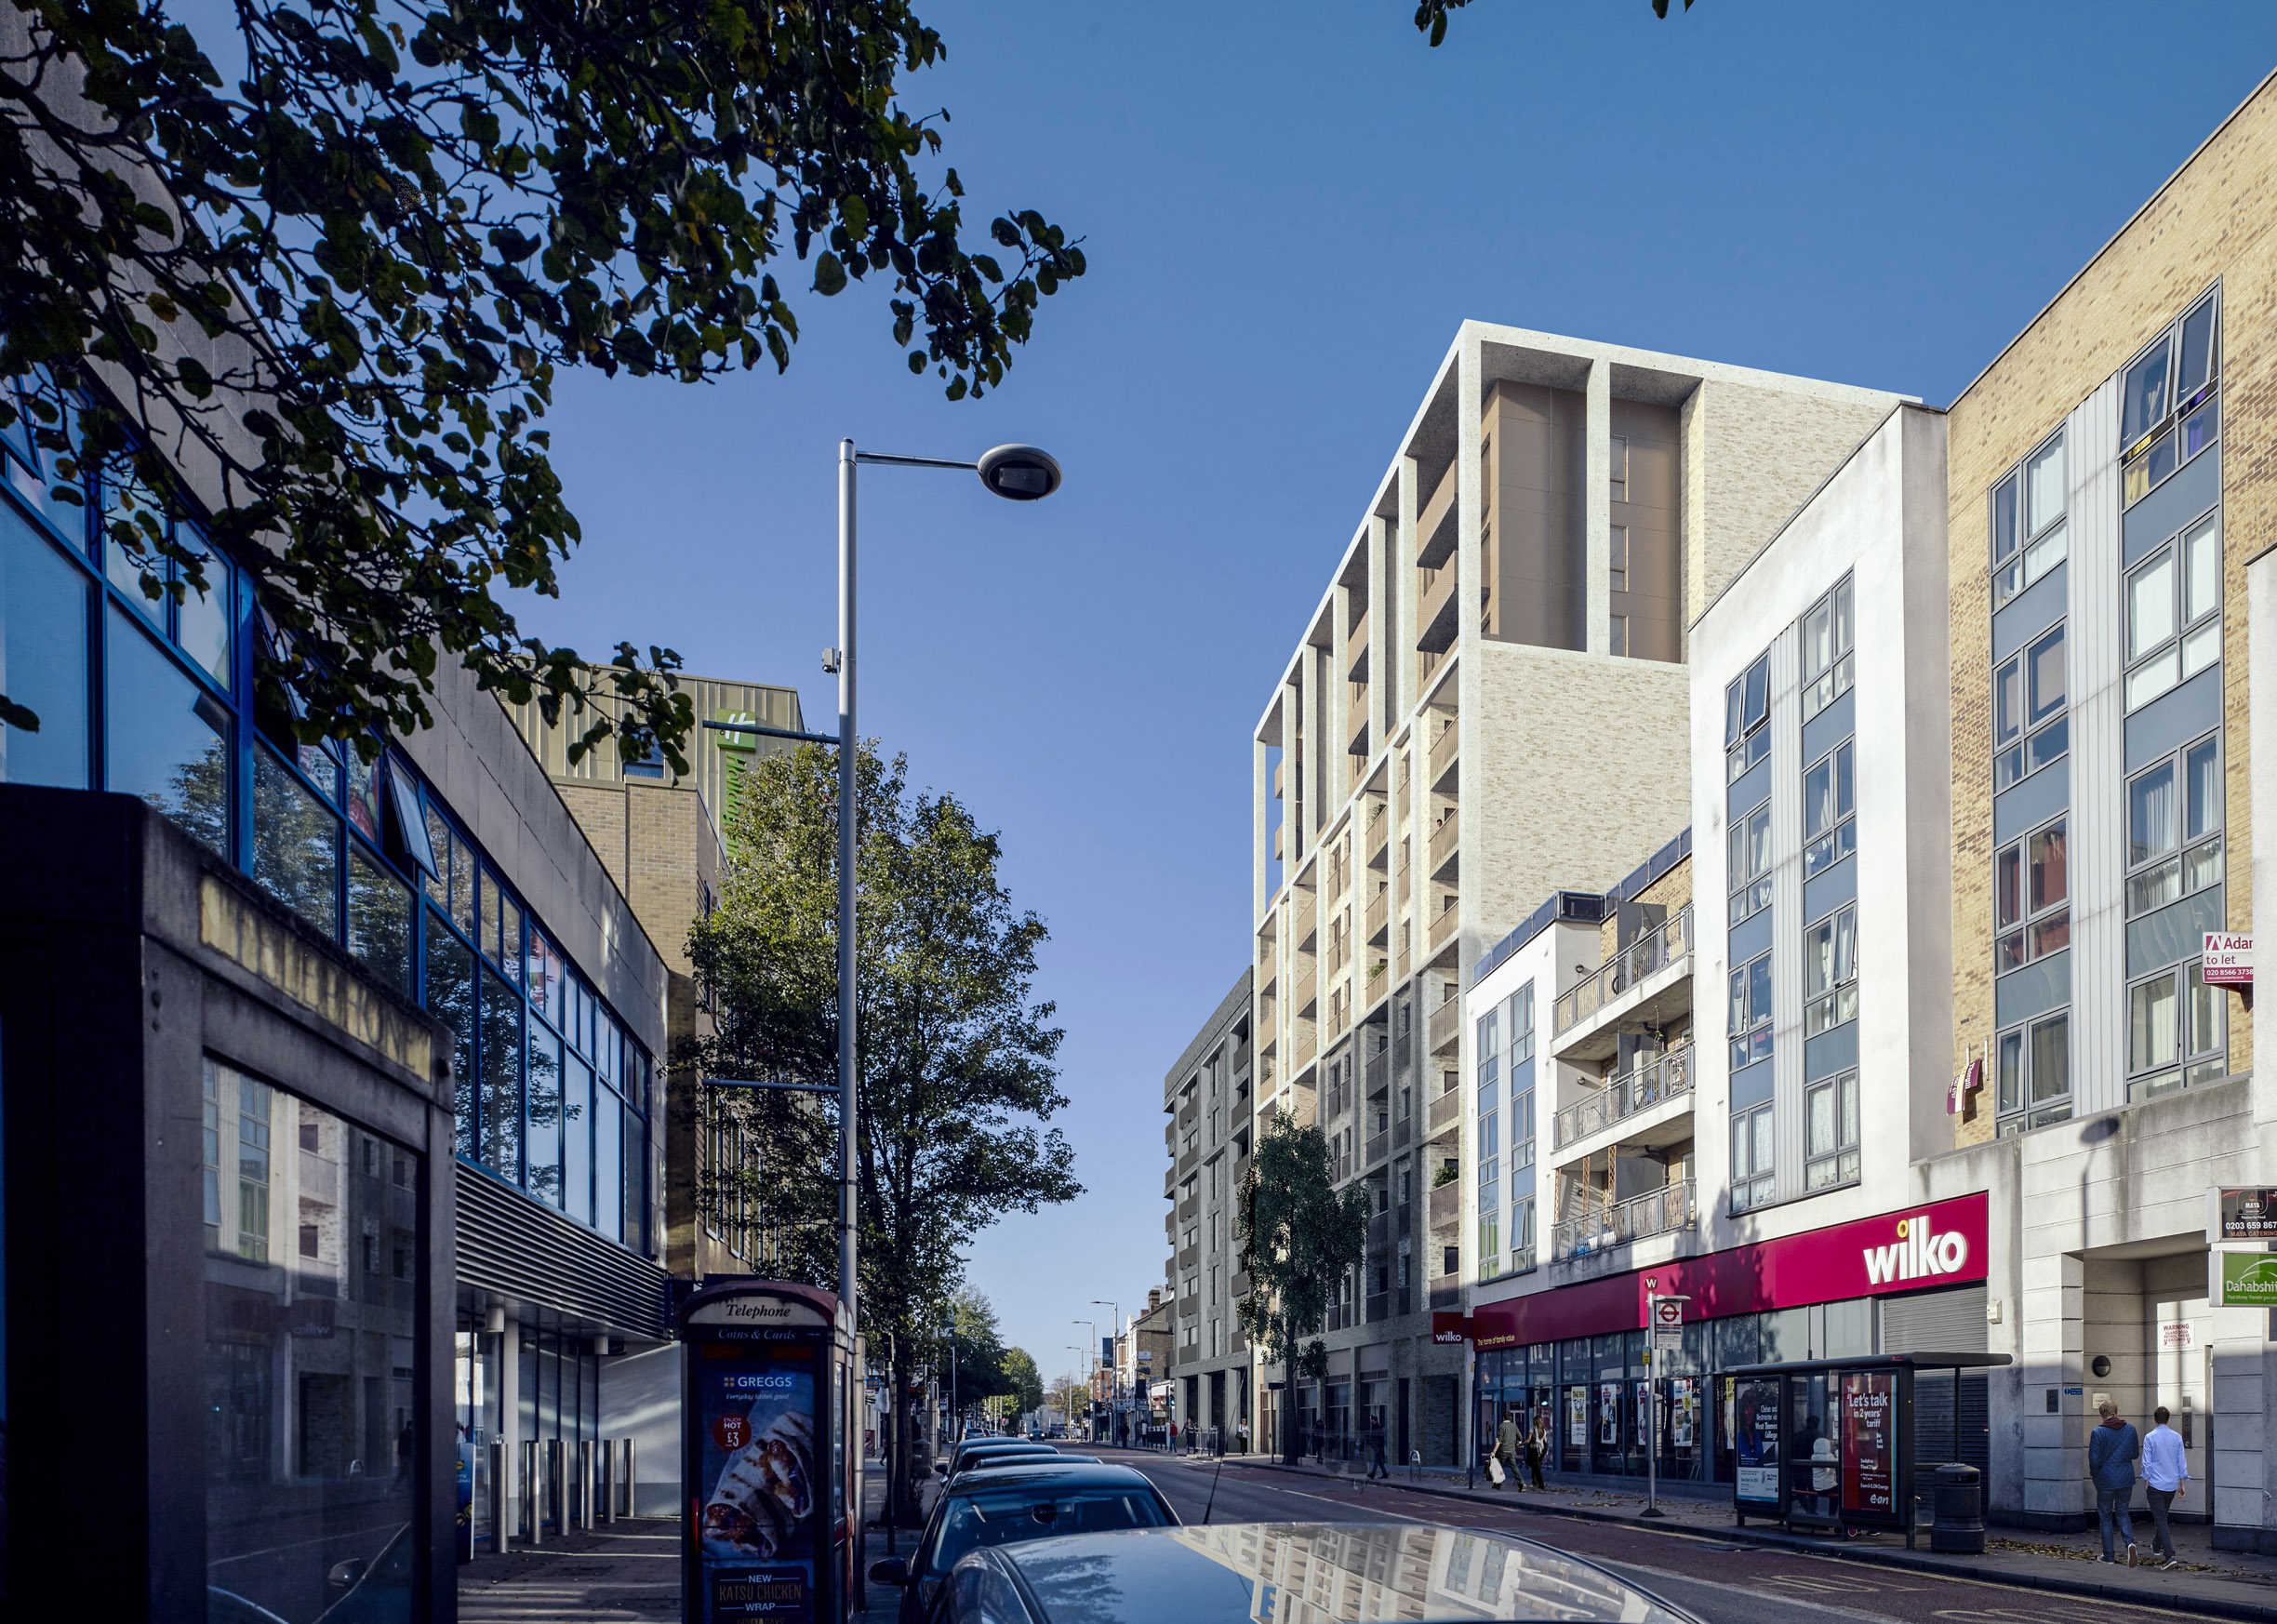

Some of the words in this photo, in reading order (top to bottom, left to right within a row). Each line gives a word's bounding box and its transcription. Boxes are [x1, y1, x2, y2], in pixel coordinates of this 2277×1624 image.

[722, 752, 747, 826] Holiday
[2206, 956, 2218, 965] to
[2222, 954, 2236, 965] let
[1863, 1215, 1967, 1285] wilko
[1646, 1279, 1657, 1288] W
[726, 1304, 791, 1318] Telephone
[718, 1329, 749, 1339] Coins
[751, 1329, 761, 1339] &
[764, 1329, 796, 1340] Cards
[1436, 1331, 1462, 1342] wilko
[738, 1377, 792, 1387] GREGGS
[1870, 1392, 1888, 1407] talk
[1853, 1408, 1859, 1418] in
[1860, 1408, 1864, 1418] 2
[1866, 1419, 1881, 1428] tariff
[727, 1432, 739, 1447] £3
[1765, 1430, 1778, 1440] College
[748, 1574, 772, 1583] NEW
[719, 1585, 753, 1601] KATSU
[757, 1584, 802, 1600] CHICKEN
[745, 1602, 776, 1611] WRAP
